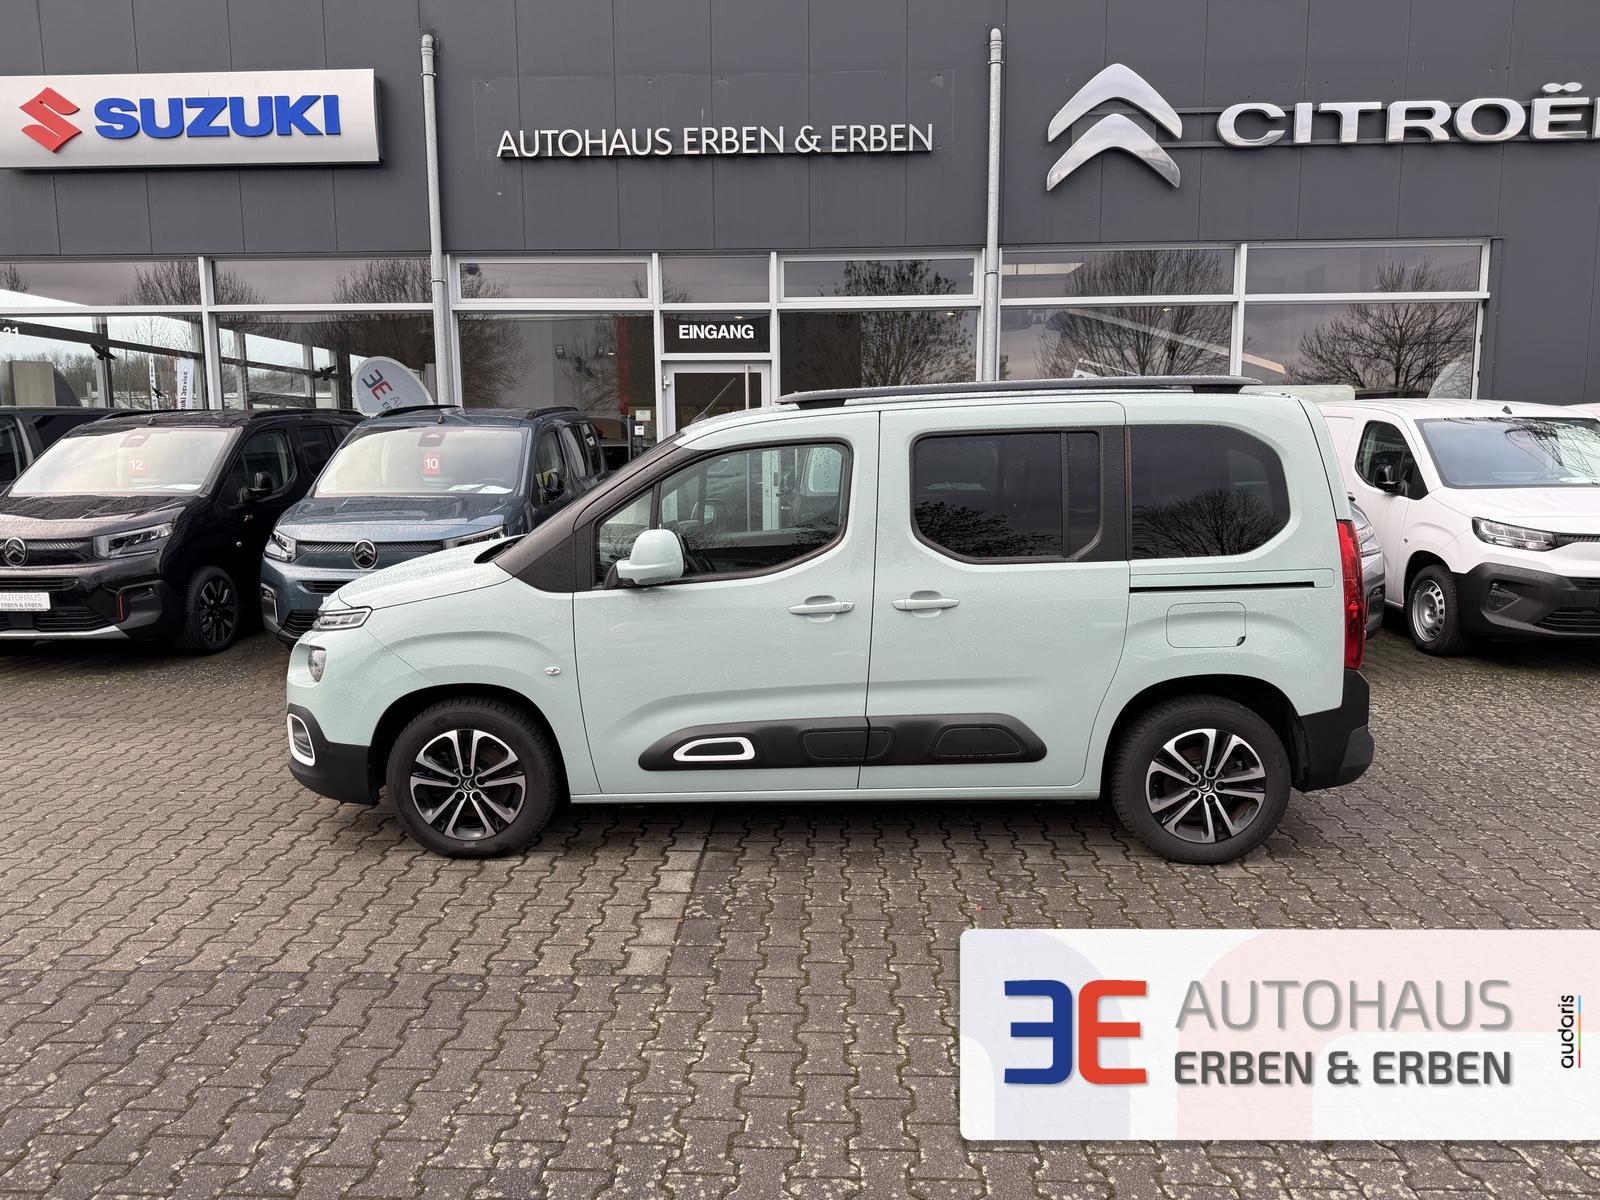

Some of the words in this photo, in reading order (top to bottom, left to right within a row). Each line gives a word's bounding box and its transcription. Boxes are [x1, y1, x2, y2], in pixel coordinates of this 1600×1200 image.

[94, 94, 340, 139] SUZUKI
[497, 127, 673, 158] AUTOHAUS
[683, 126, 784, 155] ERBEN
[794, 125, 822, 153] &
[831, 124, 934, 153] ERBEN
[678, 324, 754, 339] EINGANG
[130, 459, 144, 471] 12
[425, 458, 439, 469] 10
[0, 593, 42, 602] AUTOHAUS
